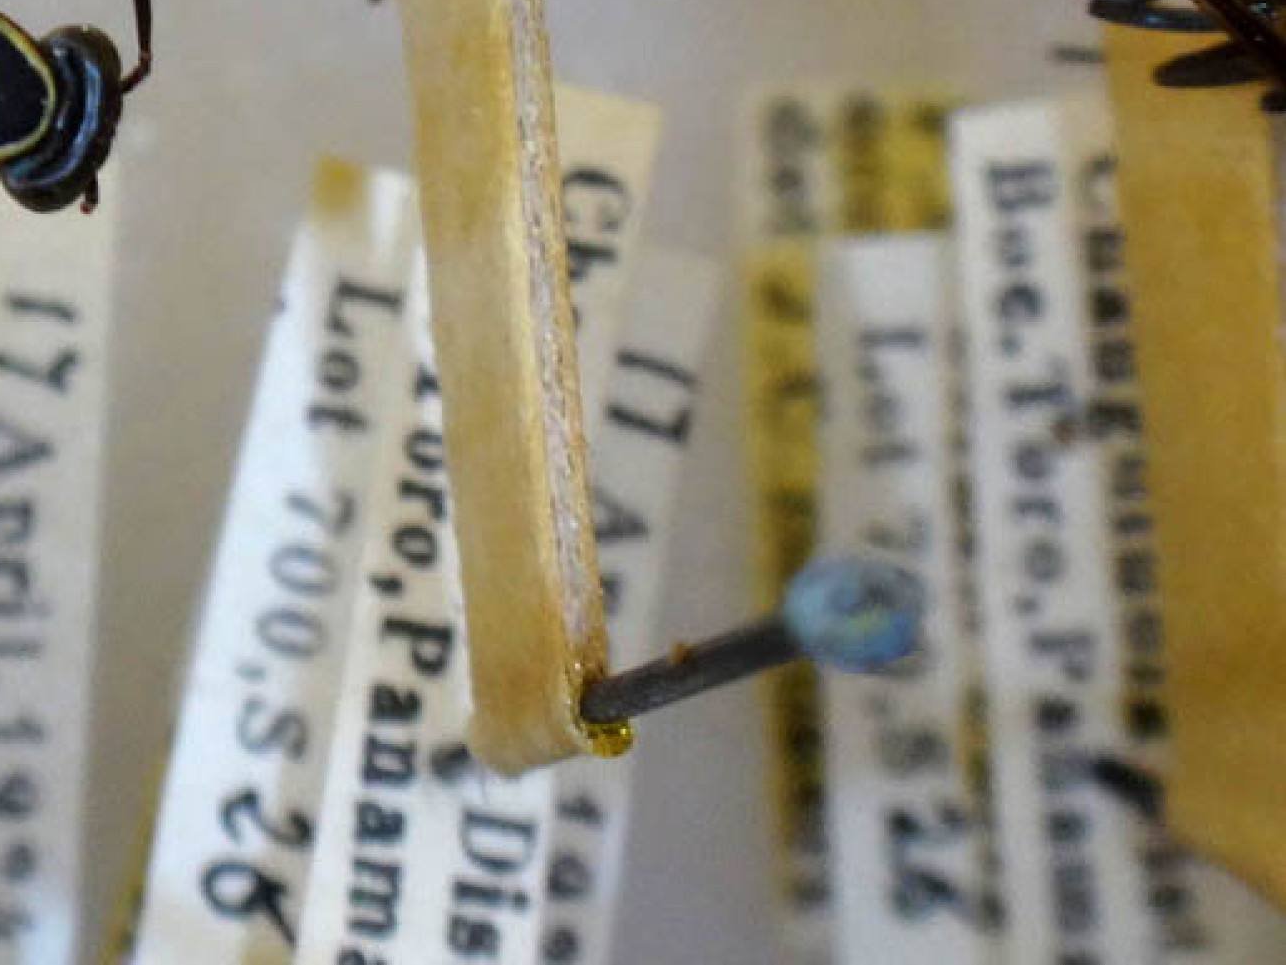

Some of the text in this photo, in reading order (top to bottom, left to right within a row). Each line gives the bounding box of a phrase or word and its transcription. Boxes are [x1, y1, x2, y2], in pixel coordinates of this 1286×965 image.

[306, 273, 404, 433] Lot
[235, 488, 356, 762] 700,S
[446, 806, 538, 963] Dis
